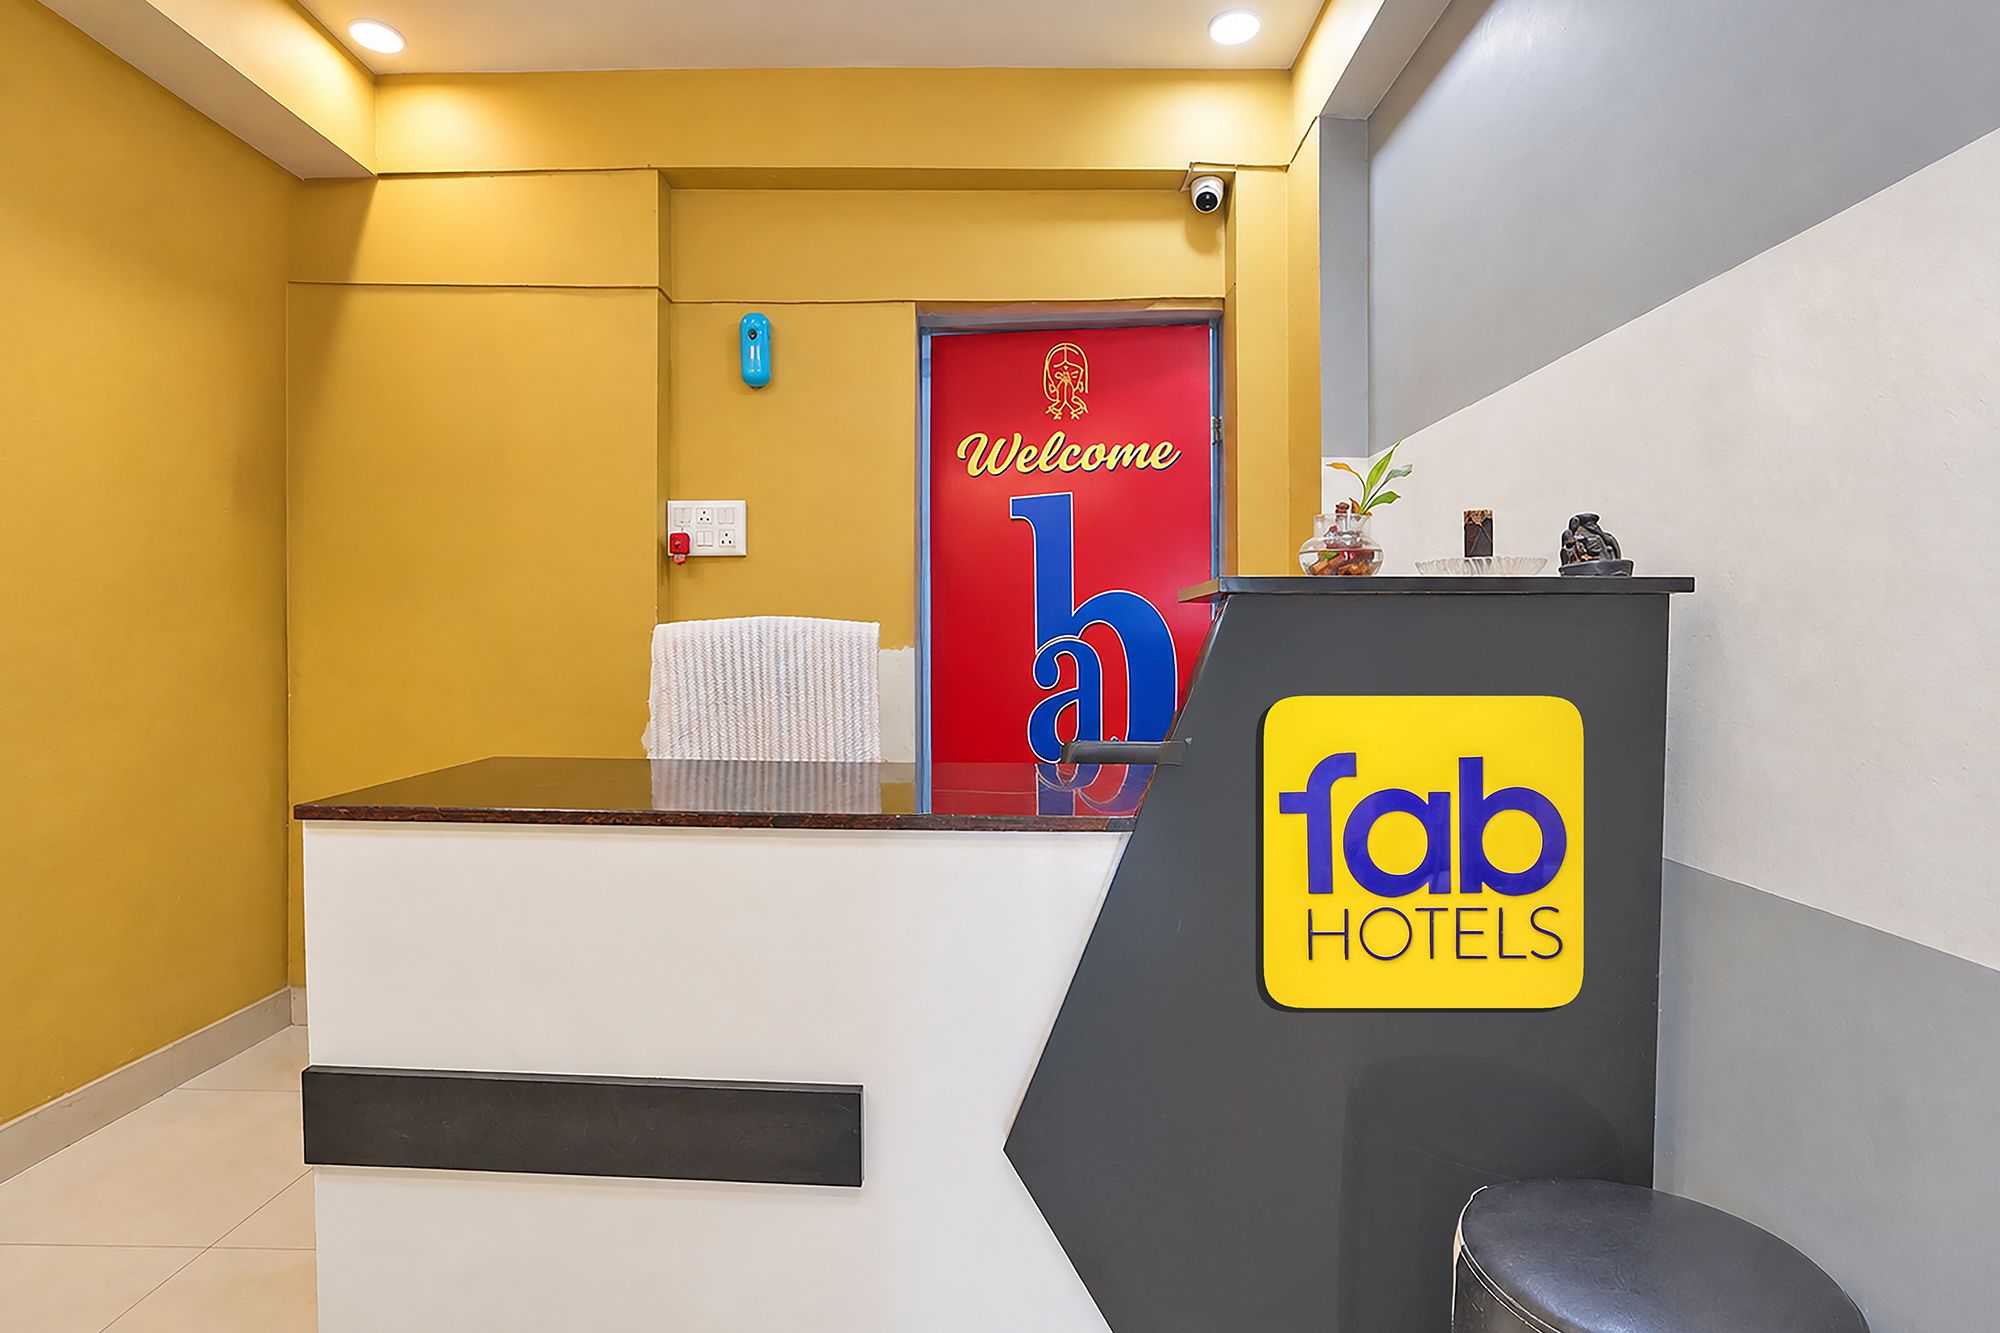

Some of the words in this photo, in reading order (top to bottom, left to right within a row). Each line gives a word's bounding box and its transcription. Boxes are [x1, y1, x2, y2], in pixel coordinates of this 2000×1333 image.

[956, 430, 1182, 477] Welcome
[1279, 752, 1567, 898] fab
[1307, 906, 1563, 961] HOTELS
